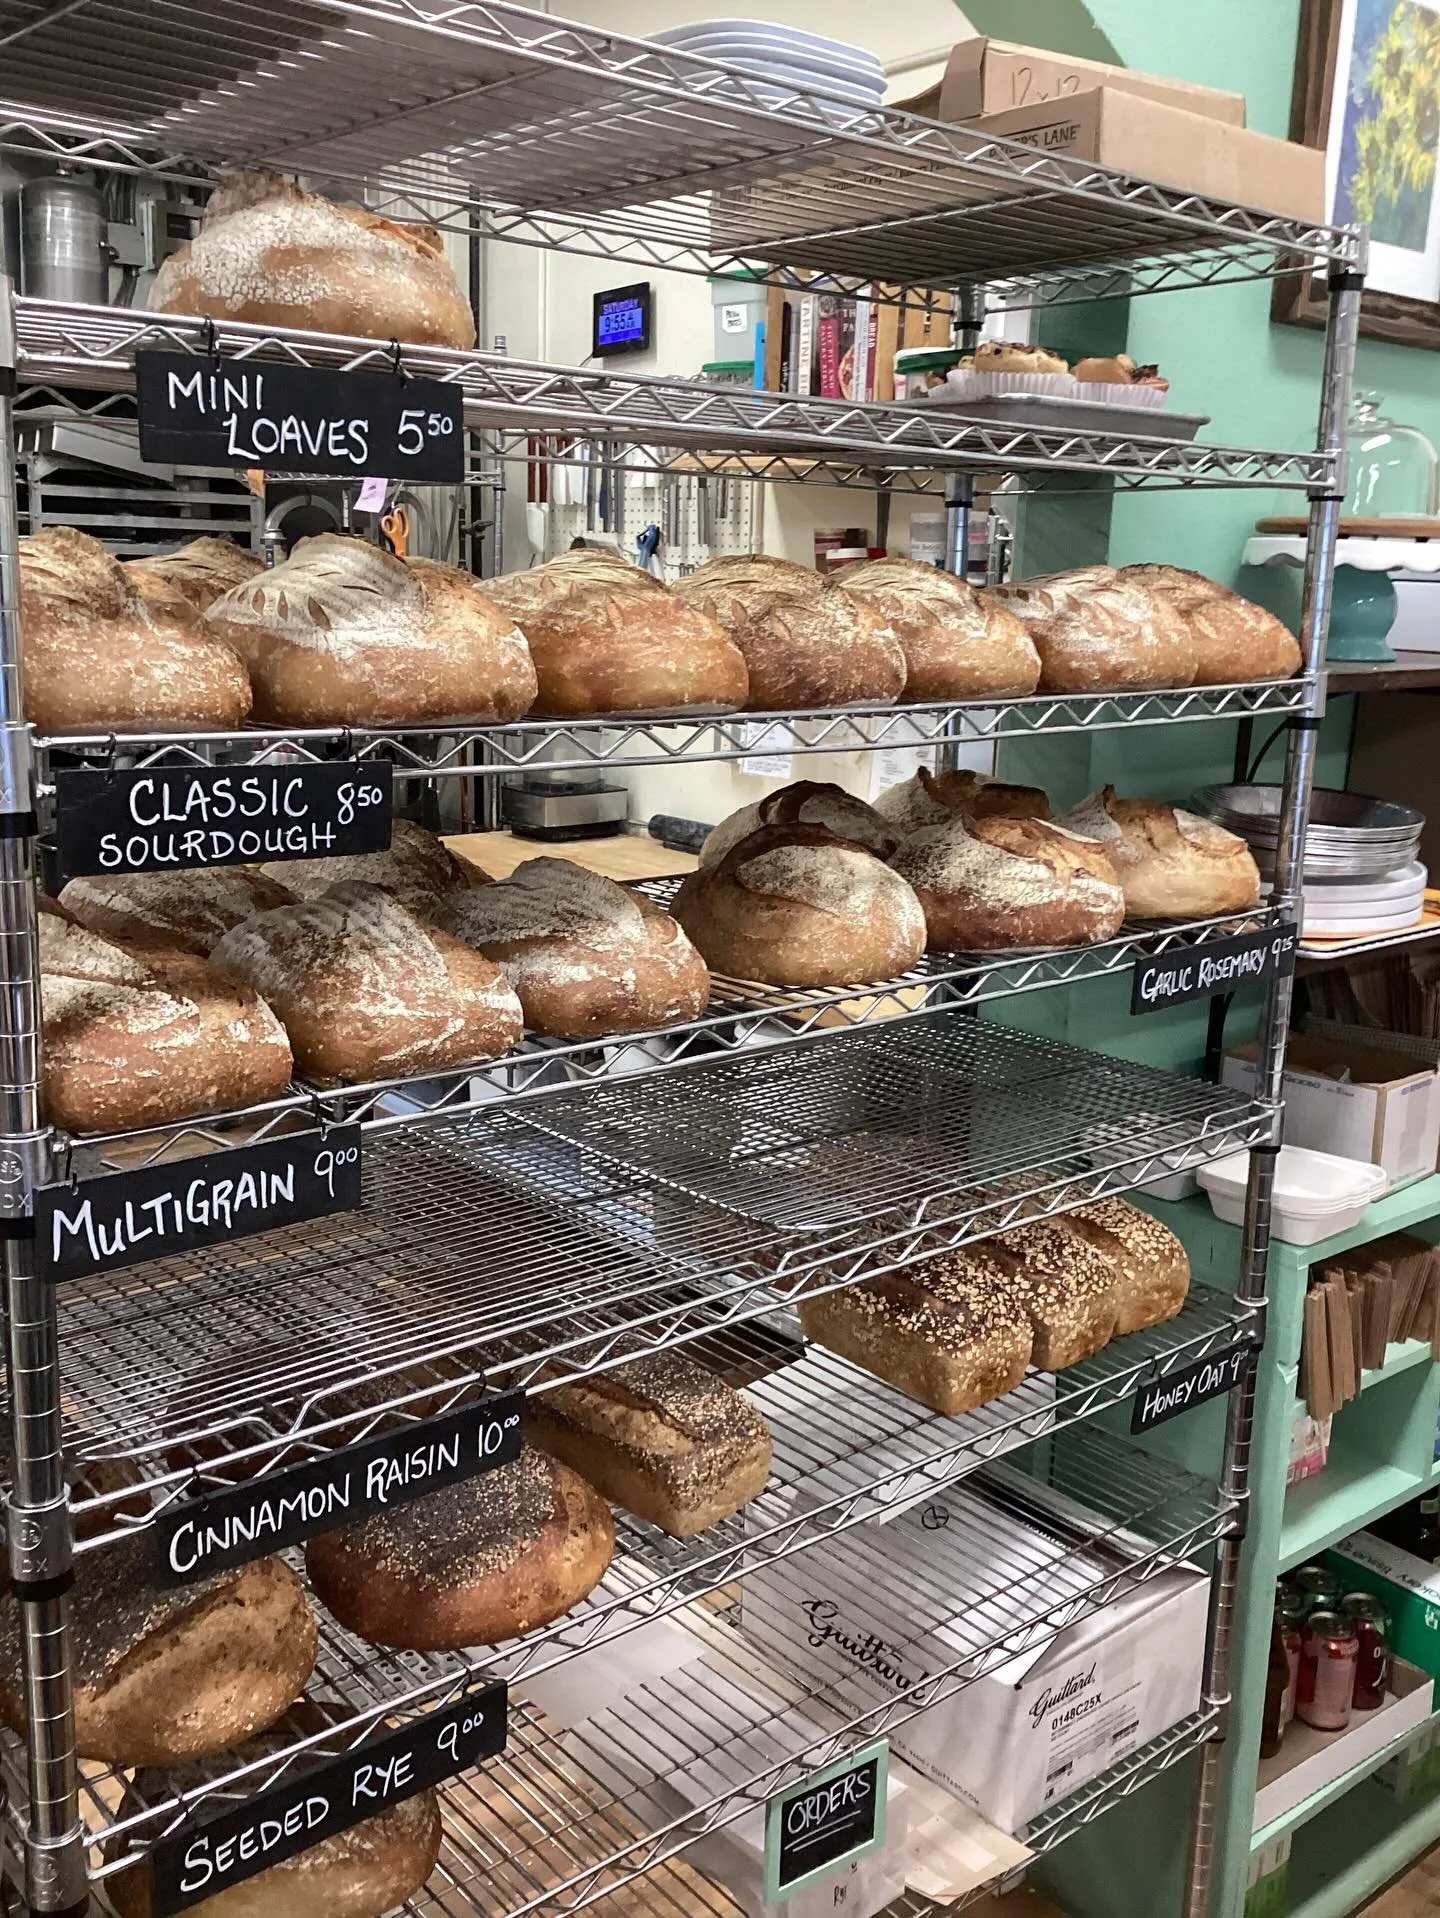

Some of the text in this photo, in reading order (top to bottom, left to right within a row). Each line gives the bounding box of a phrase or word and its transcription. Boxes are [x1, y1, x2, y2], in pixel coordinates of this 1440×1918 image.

[1043, 123, 1079, 146] LANE
[167, 371, 264, 414] MINI
[222, 412, 369, 464] LOAVES
[128, 778, 309, 826] CLASSIC
[98, 822, 337, 867] SOURDOUGH
[1140, 966, 1193, 1002] GARLIC
[1197, 946, 1268, 989] ROSEMARY
[53, 1163, 296, 1262] MULTIGRAIN
[1141, 1375, 1197, 1423] HONEY
[1197, 1360, 1230, 1394] OAT
[168, 1473, 350, 1573] CINNAMON
[365, 1432, 461, 1502] RAISIN
[1029, 1662, 1097, 1729] Guittard
[1051, 1692, 1102, 1730] 0148C25X
[180, 1797, 329, 1892] SEEDED
[352, 1752, 415, 1808] RYE
[787, 1769, 871, 1835] ORDERS
